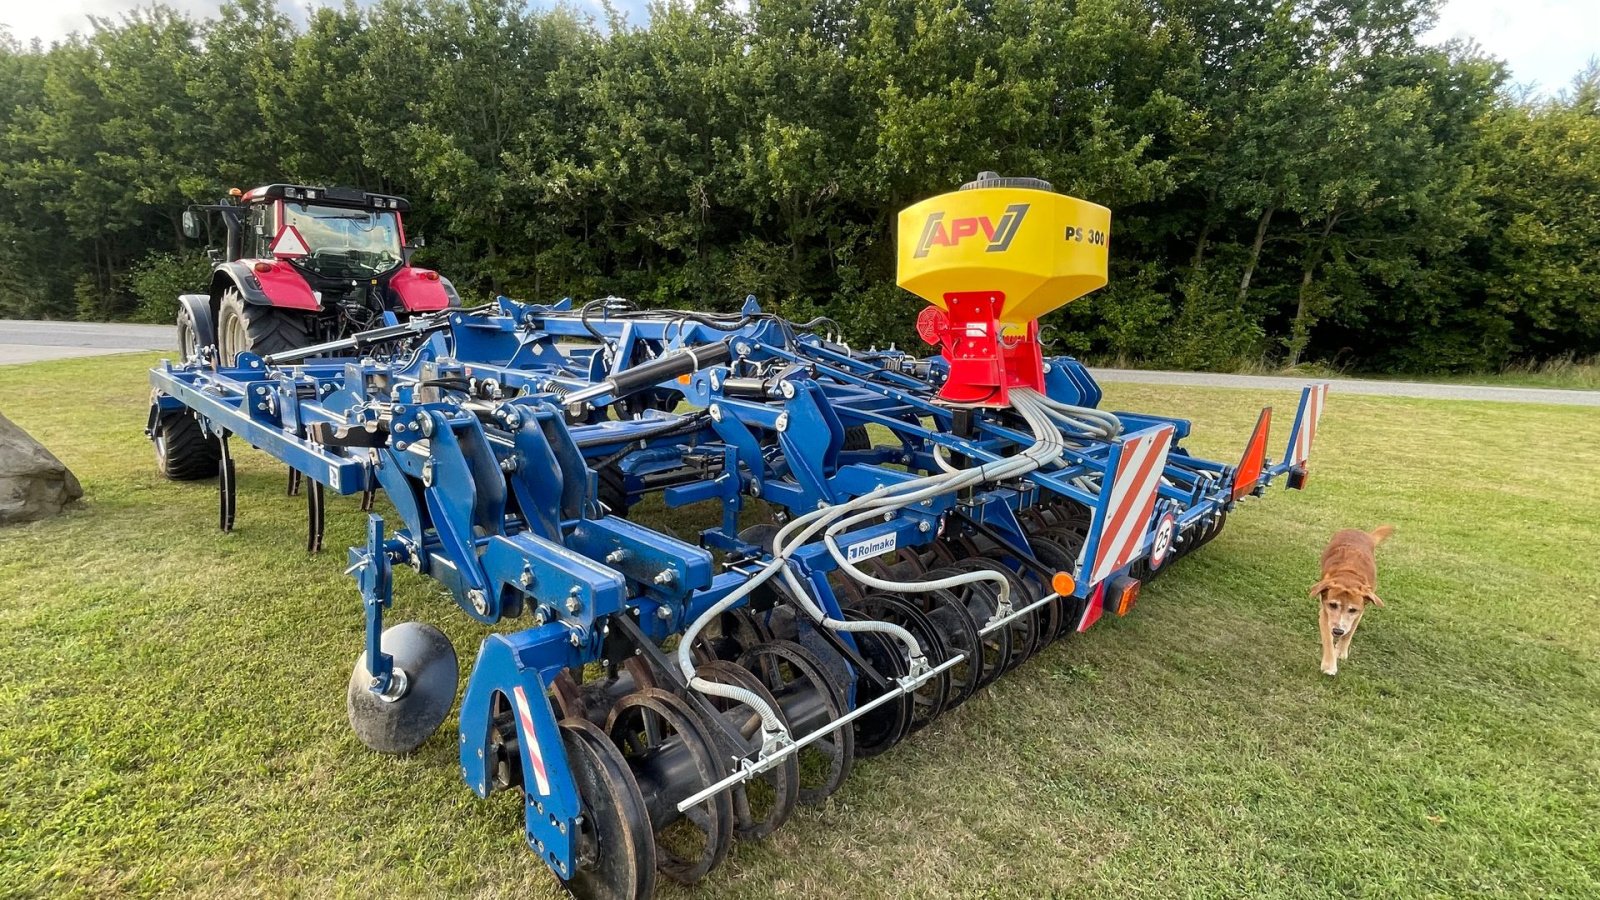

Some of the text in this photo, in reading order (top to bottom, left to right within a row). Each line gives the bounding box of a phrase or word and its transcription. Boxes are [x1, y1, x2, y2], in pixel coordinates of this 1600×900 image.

[922, 212, 1016, 250] APV
[1065, 226, 1083, 243] PS
[1088, 229, 1105, 246] 300
[858, 538, 895, 557] Rolmako
[1156, 527, 1170, 553] 25
